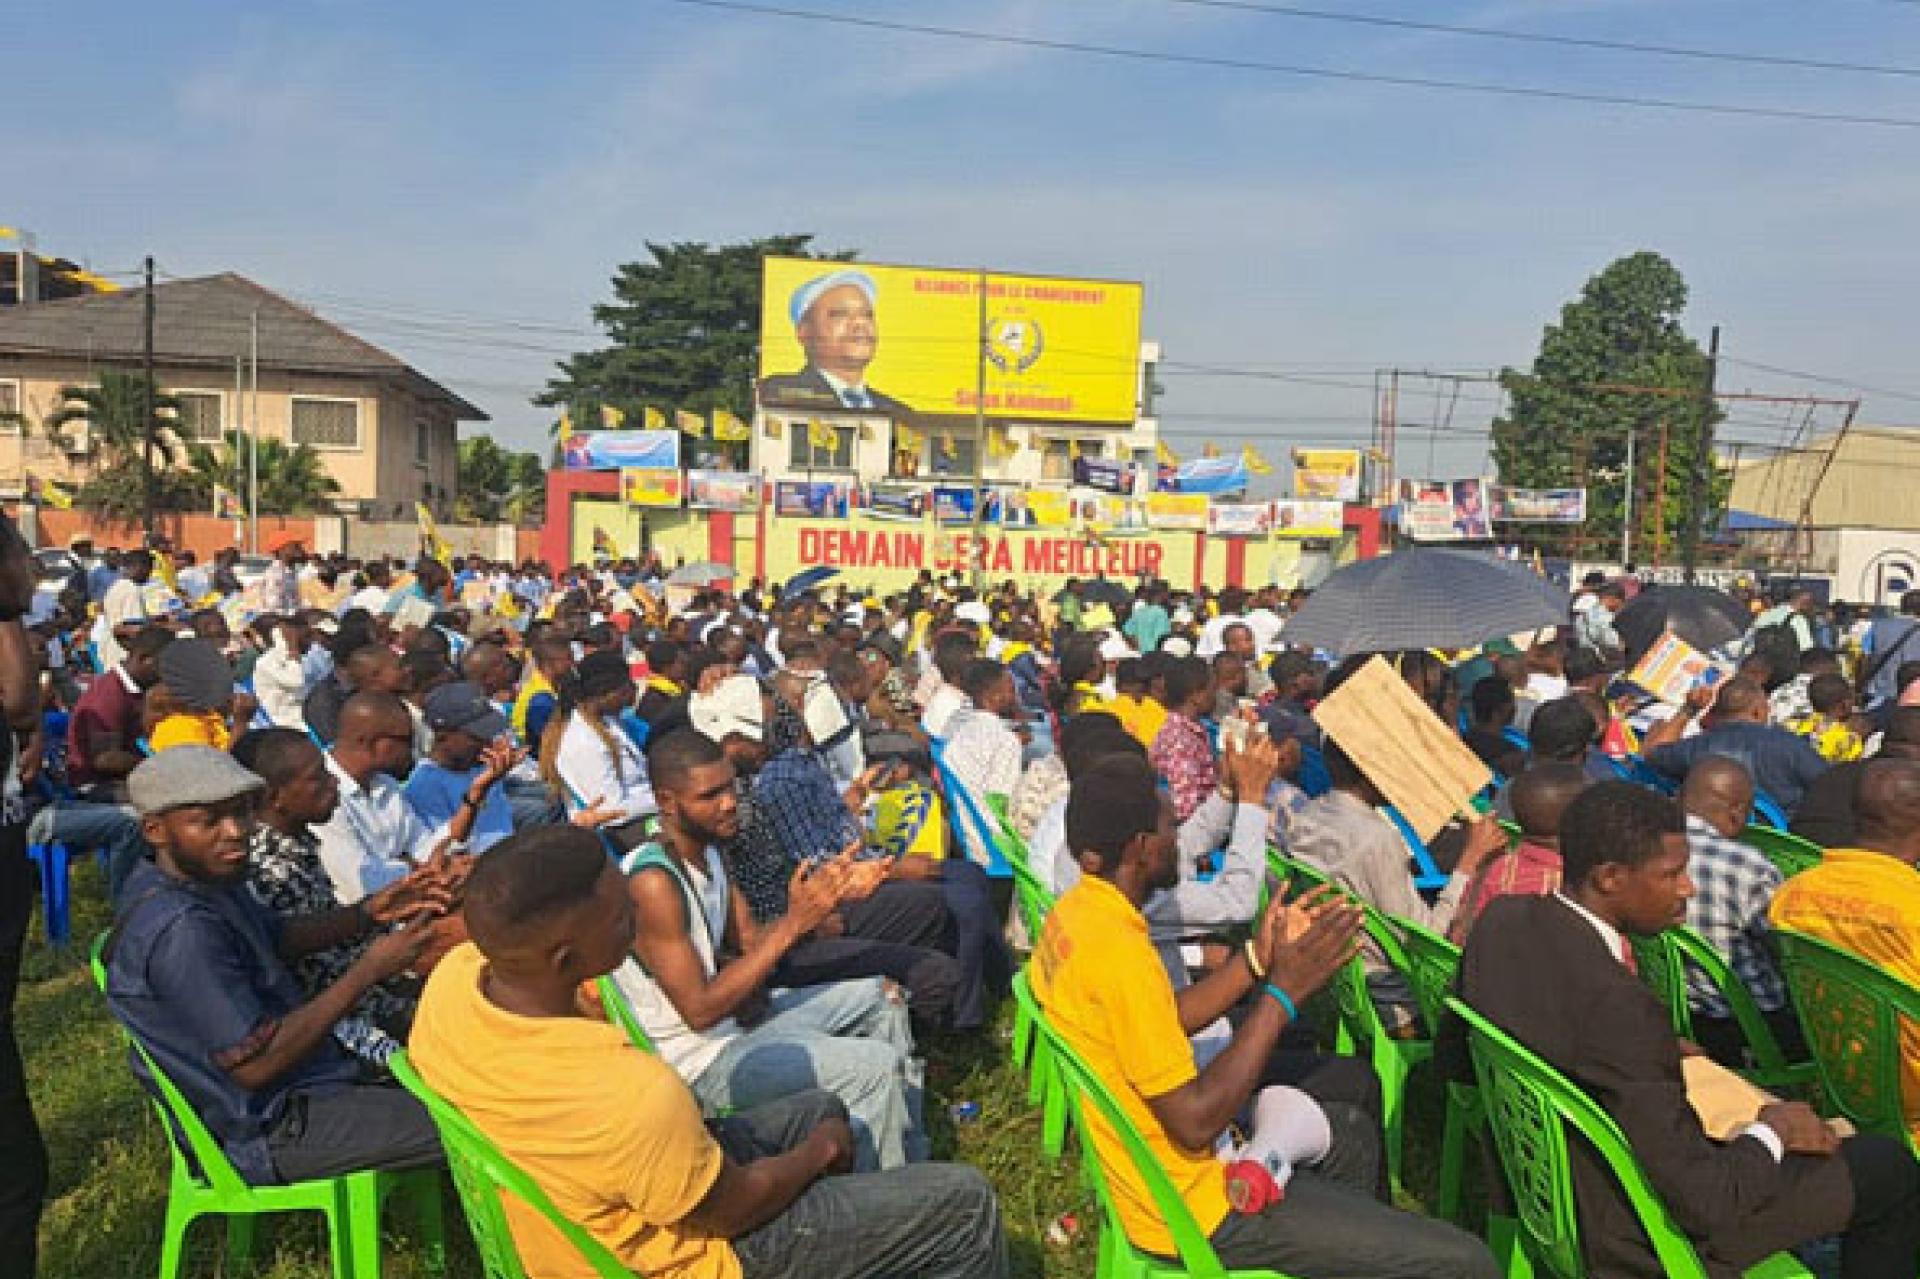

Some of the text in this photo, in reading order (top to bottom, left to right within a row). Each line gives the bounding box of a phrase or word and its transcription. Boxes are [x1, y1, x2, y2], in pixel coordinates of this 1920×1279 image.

[799, 527, 1164, 577] DEMAIN ERA MEILLEUR
